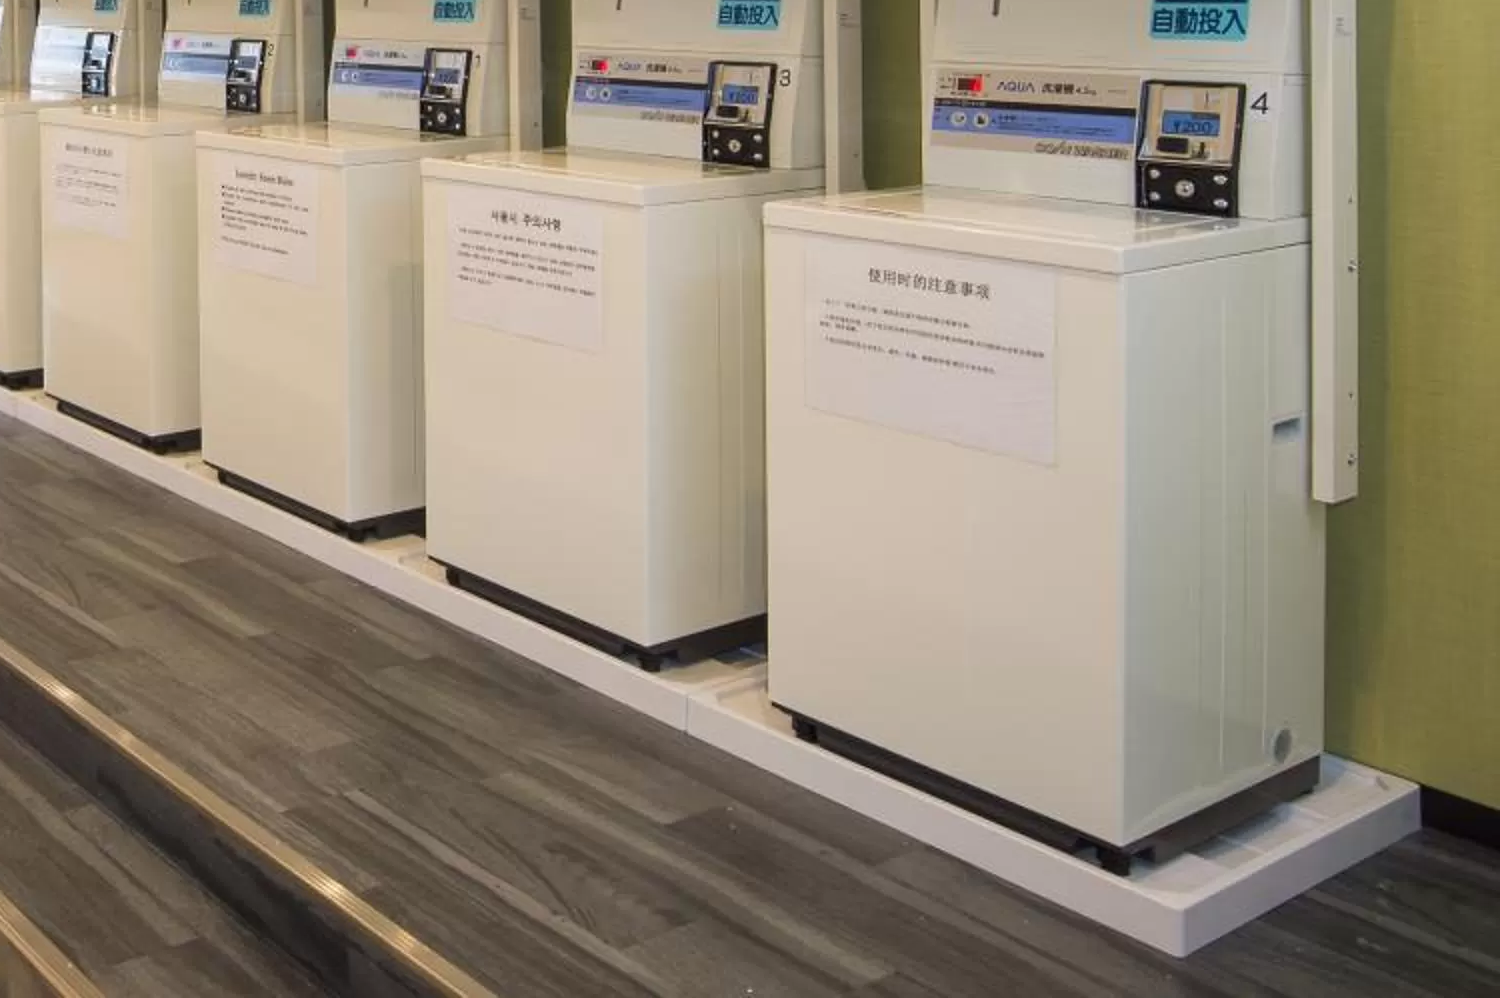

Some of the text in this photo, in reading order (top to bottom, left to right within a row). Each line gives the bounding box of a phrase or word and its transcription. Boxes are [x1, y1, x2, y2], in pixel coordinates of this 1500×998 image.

[718, 5, 780, 26] 自動投入
[1151, 7, 1247, 36] 自動投入
[779, 69, 791, 87] 3
[996, 81, 1035, 95] AQUA
[1250, 91, 1270, 115] 4
